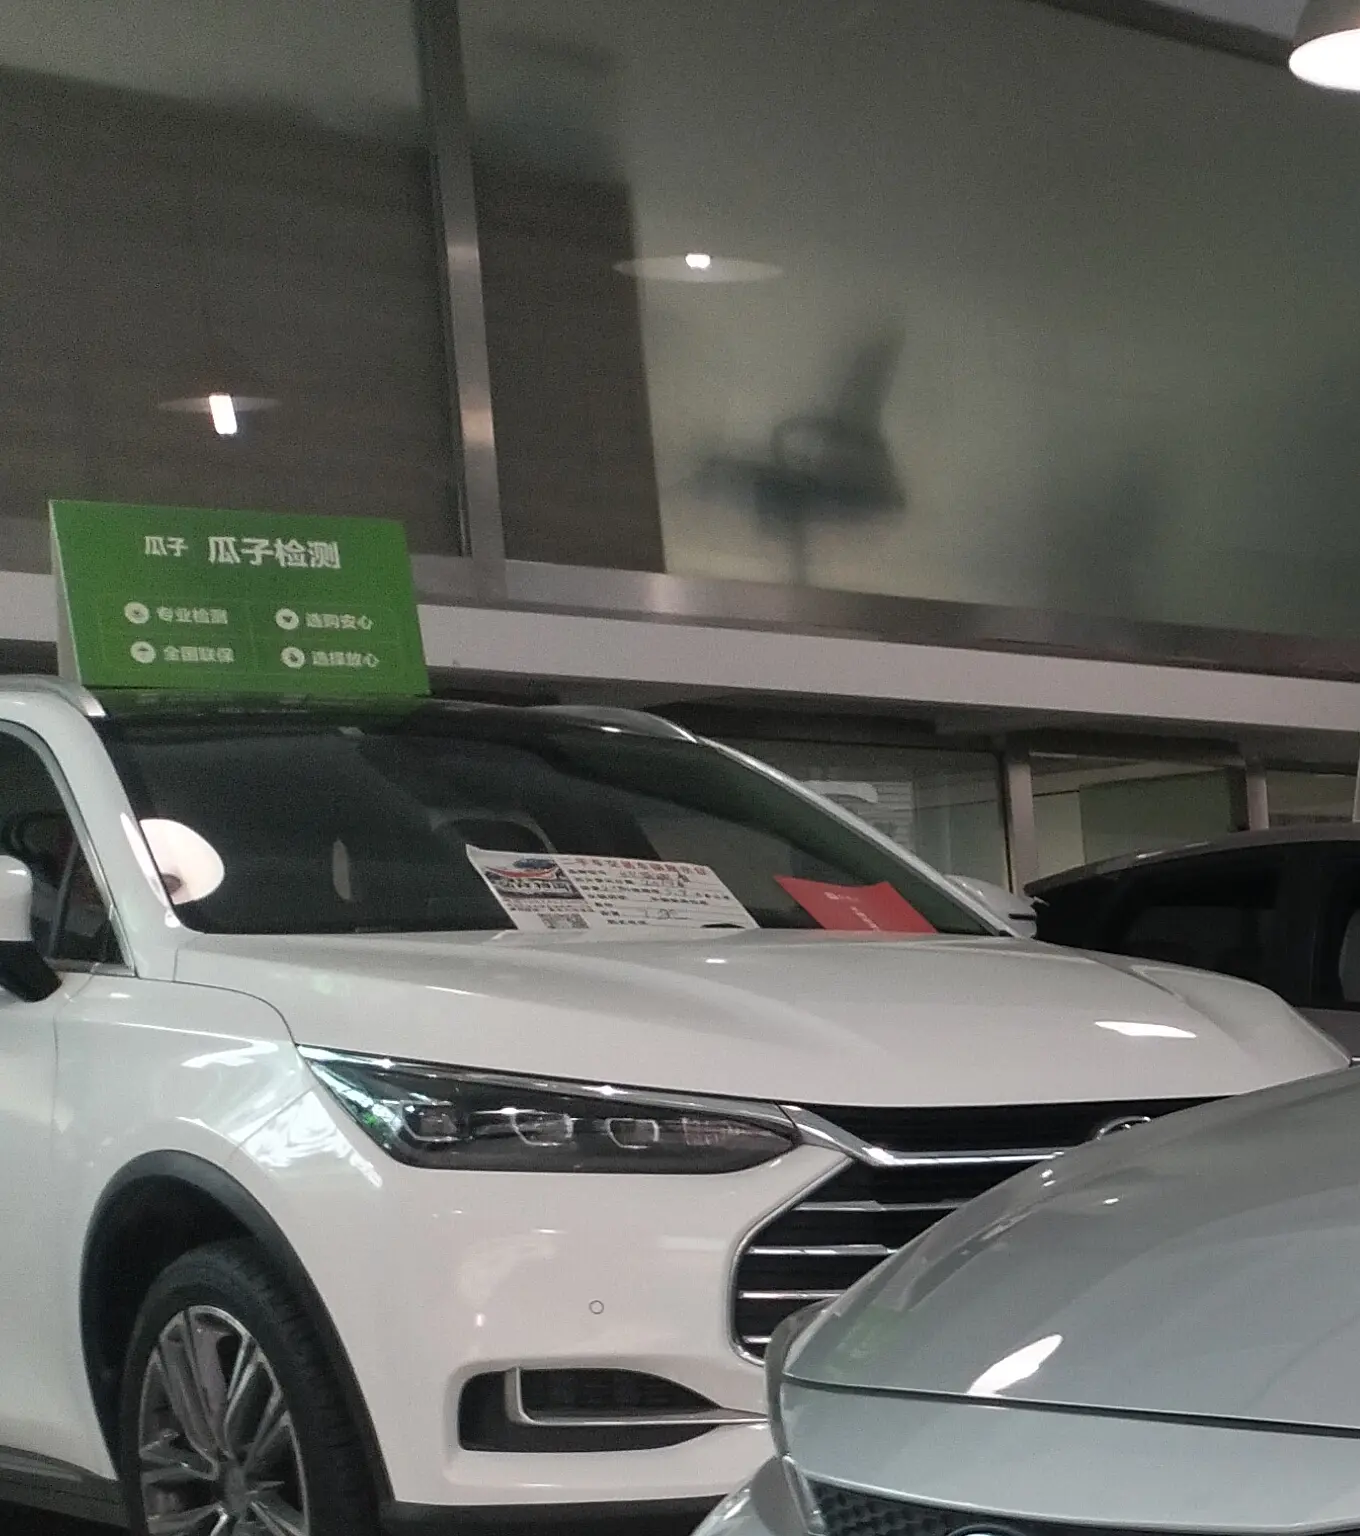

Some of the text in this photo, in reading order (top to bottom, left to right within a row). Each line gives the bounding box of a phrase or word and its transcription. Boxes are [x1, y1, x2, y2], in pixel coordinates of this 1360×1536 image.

[144, 535, 342, 570] 瓜子 瓜子检测
[156, 606, 229, 626] 专业检测
